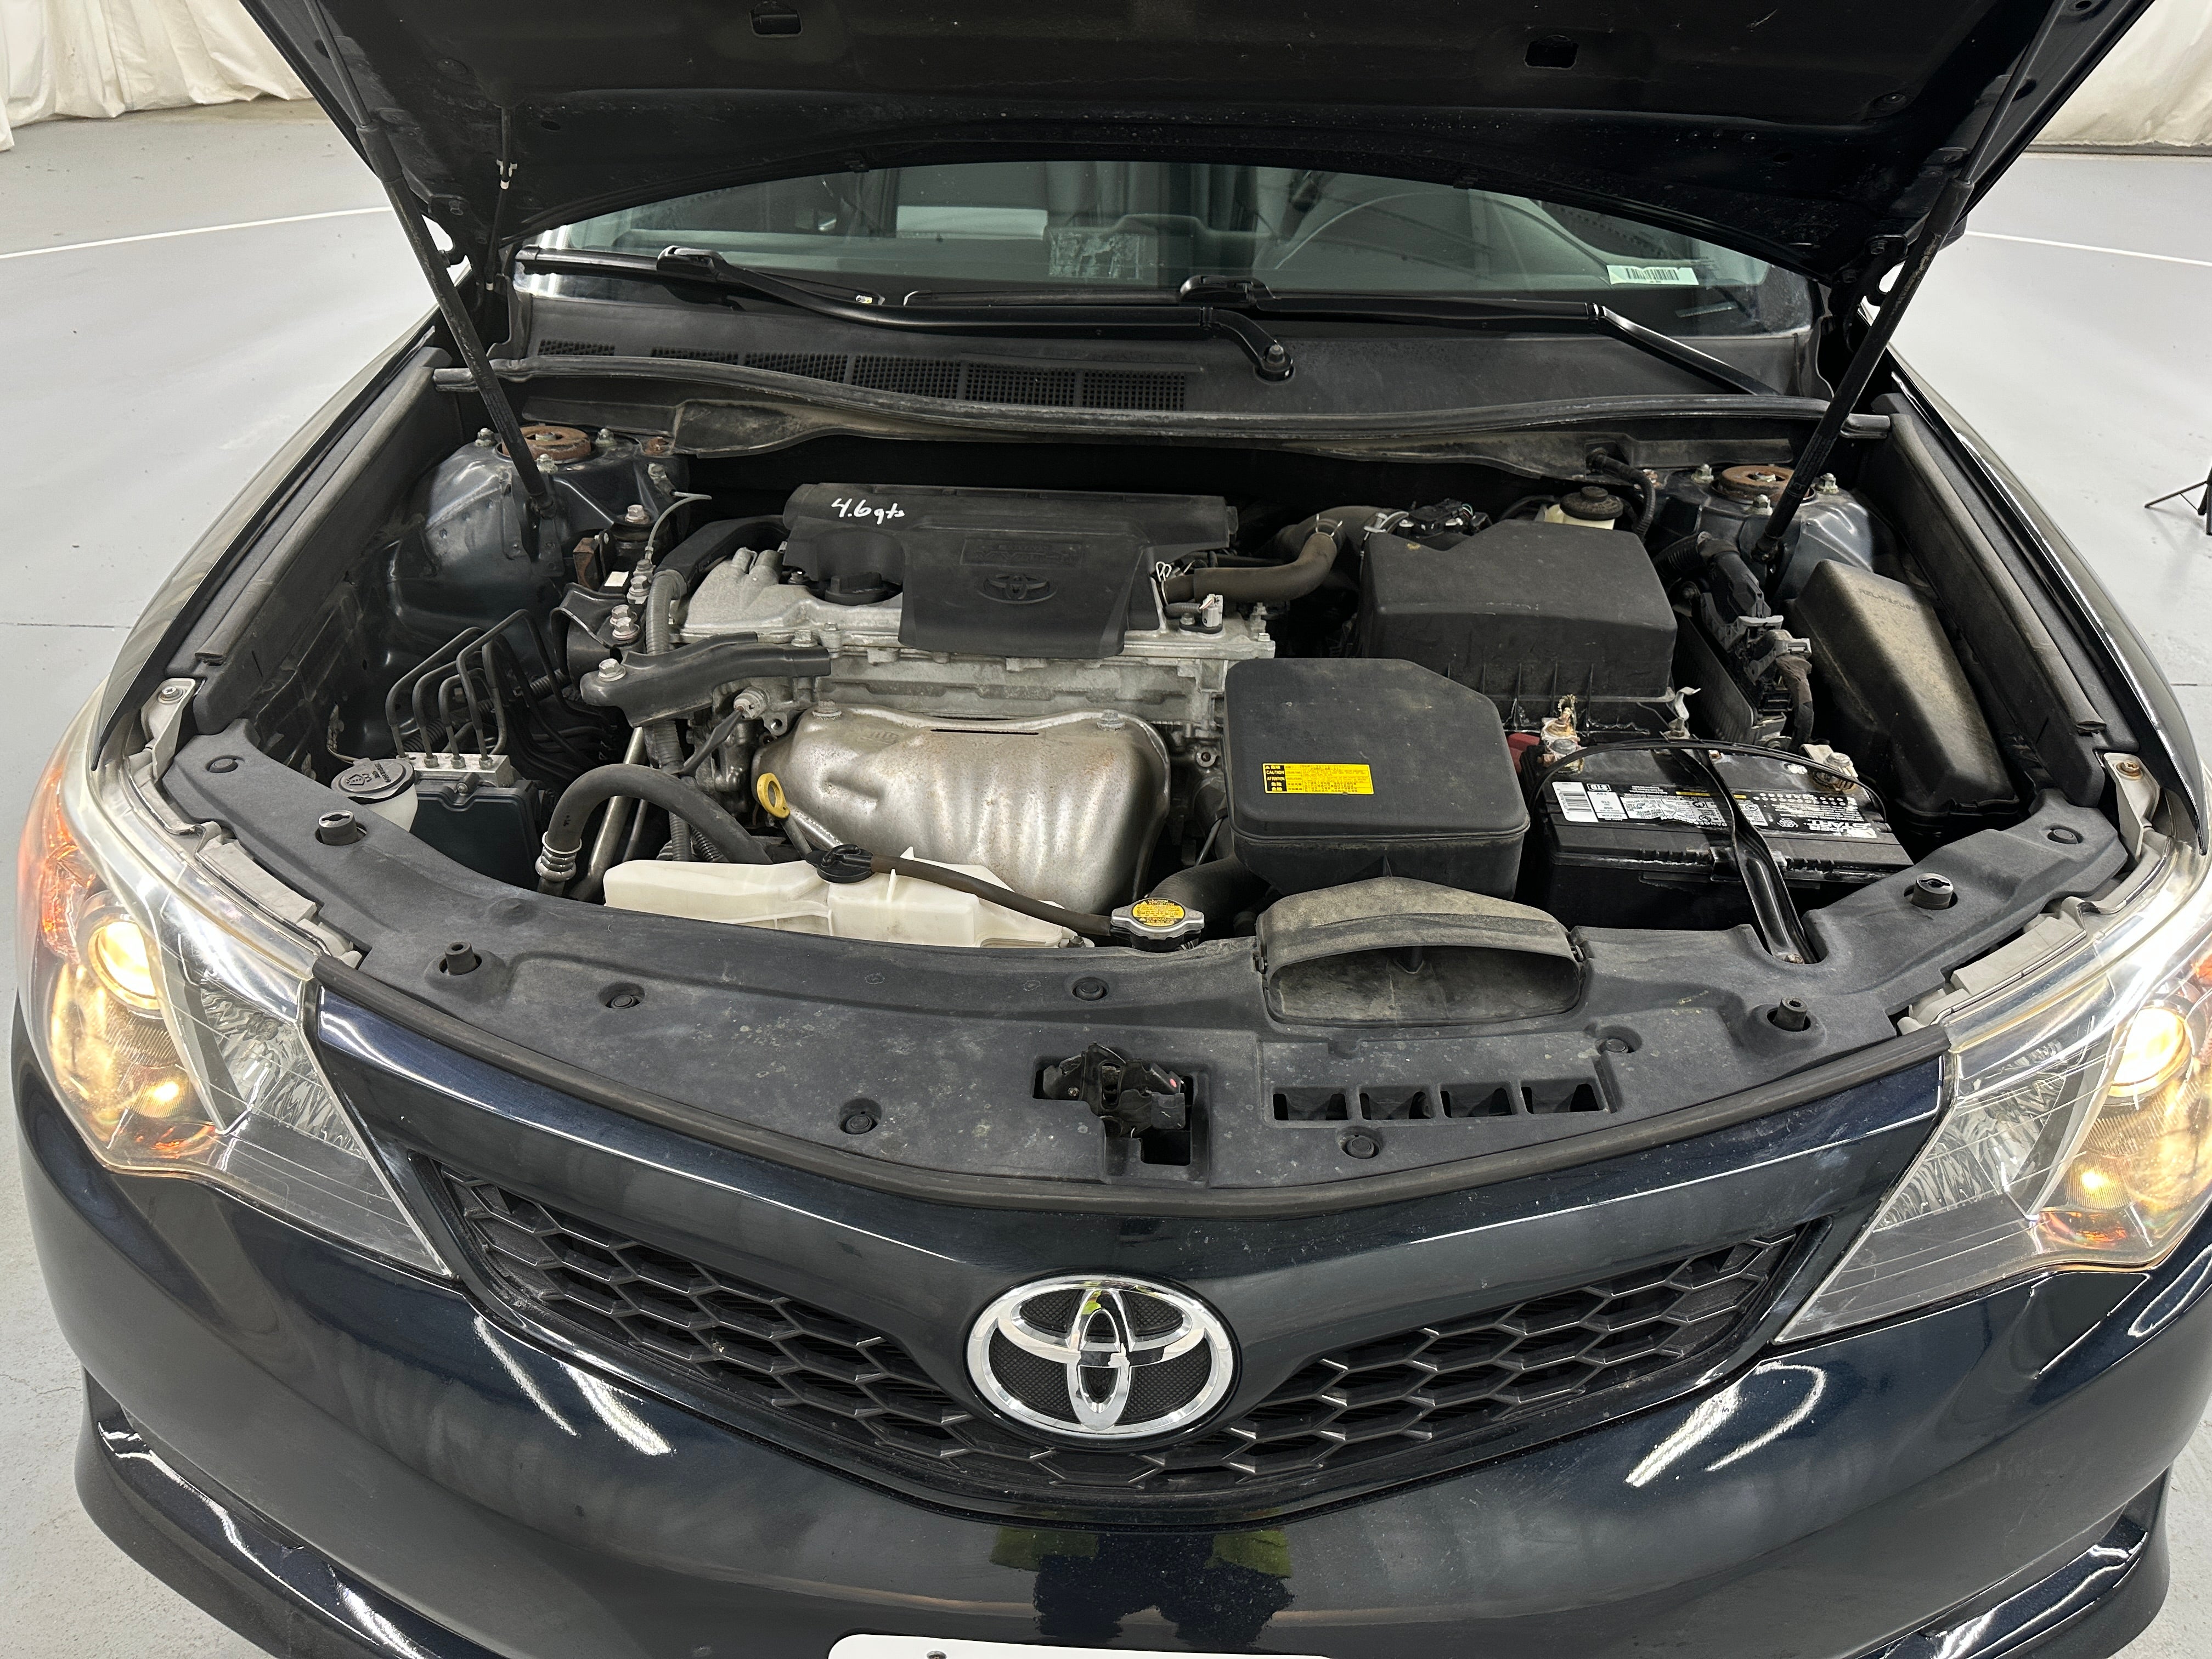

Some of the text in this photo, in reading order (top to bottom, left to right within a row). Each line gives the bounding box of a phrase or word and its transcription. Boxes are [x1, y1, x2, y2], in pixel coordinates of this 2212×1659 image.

[831, 498, 905, 525] 4.6 qts
[1807, 819, 1871, 830] START
